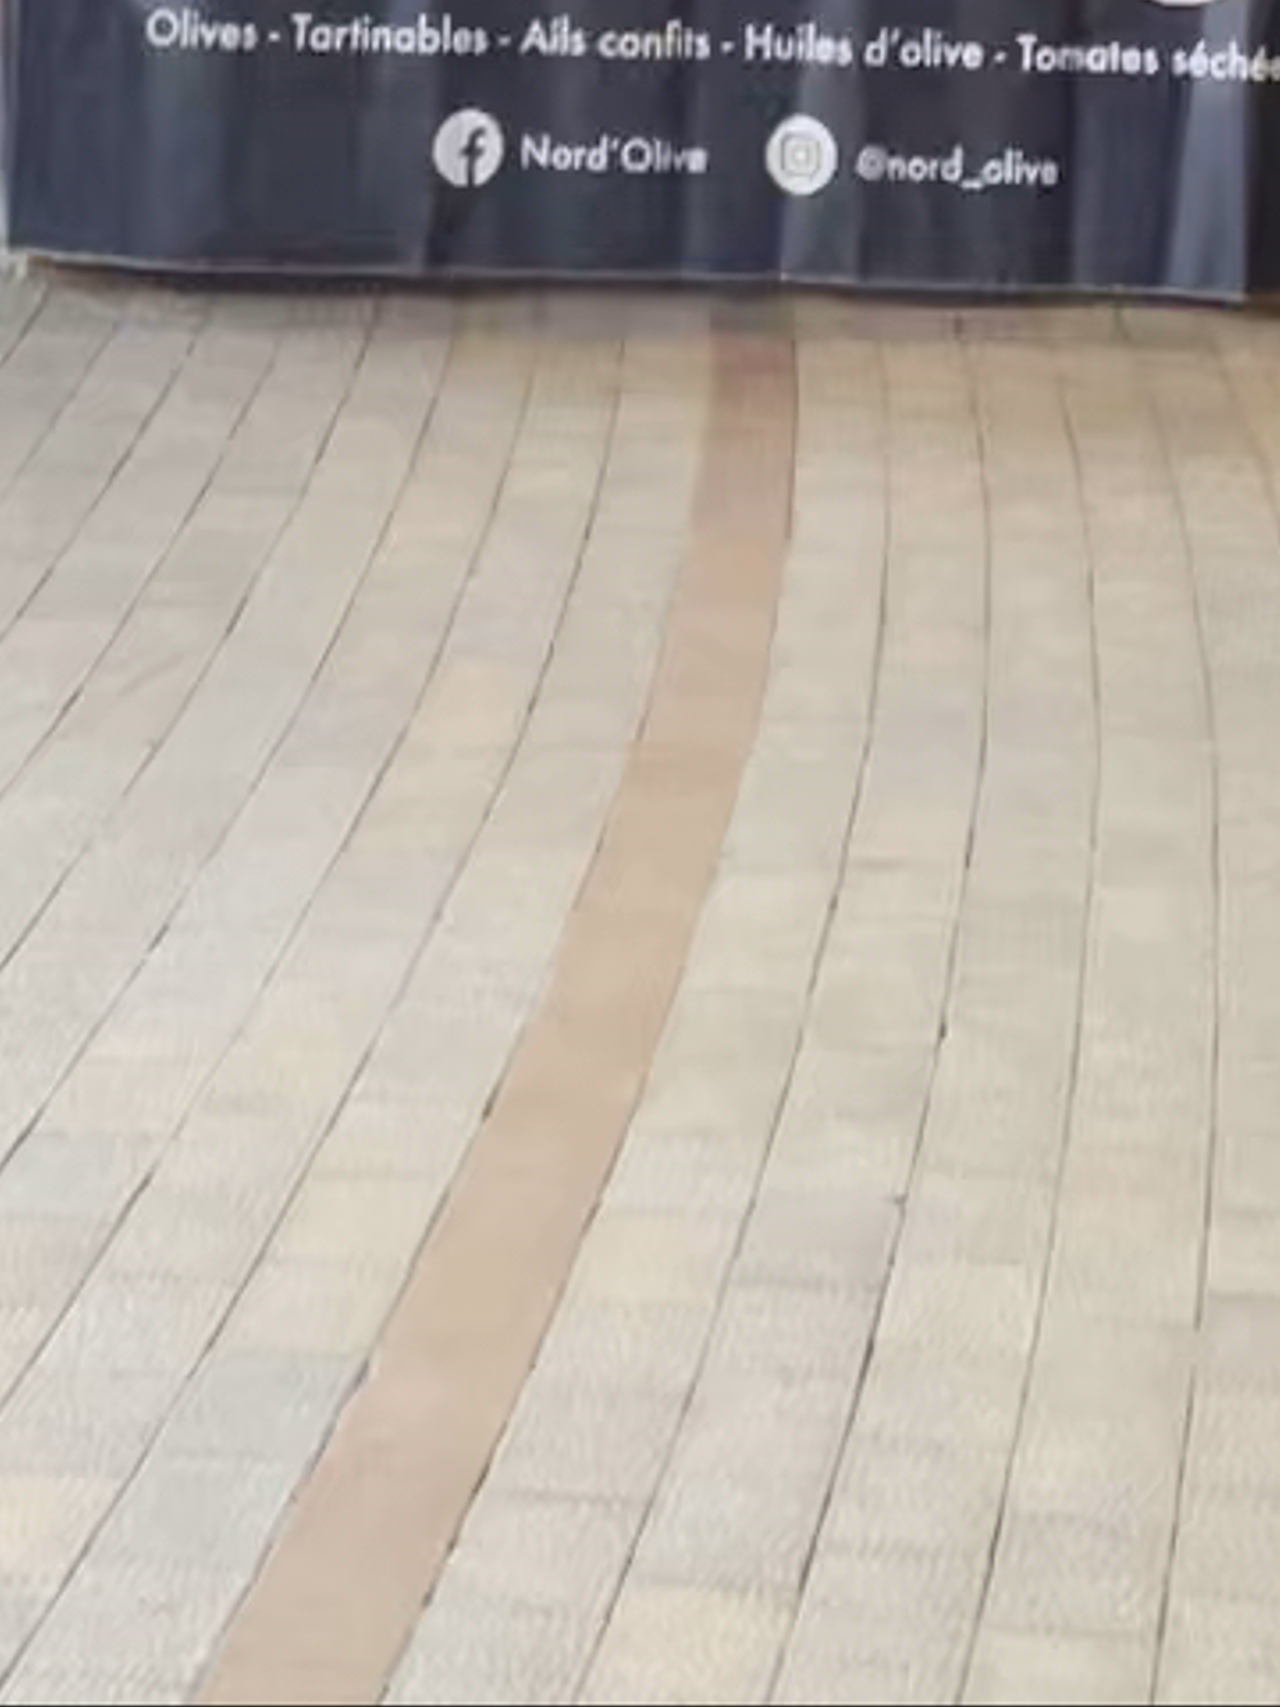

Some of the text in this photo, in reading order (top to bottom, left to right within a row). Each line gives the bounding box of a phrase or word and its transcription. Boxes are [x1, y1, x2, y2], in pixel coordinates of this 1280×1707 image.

[145, 7, 258, 50] Olives
[291, 12, 489, 56] Tartinables
[520, 17, 588, 57] Ails
[597, 19, 711, 61] confits
[744, 22, 853, 64] Huiles
[864, 27, 984, 69] d'olive
[1017, 33, 1159, 74] Tomates
[521, 134, 708, 172] Nord'Olive
[855, 144, 1059, 187] @nord_olive
